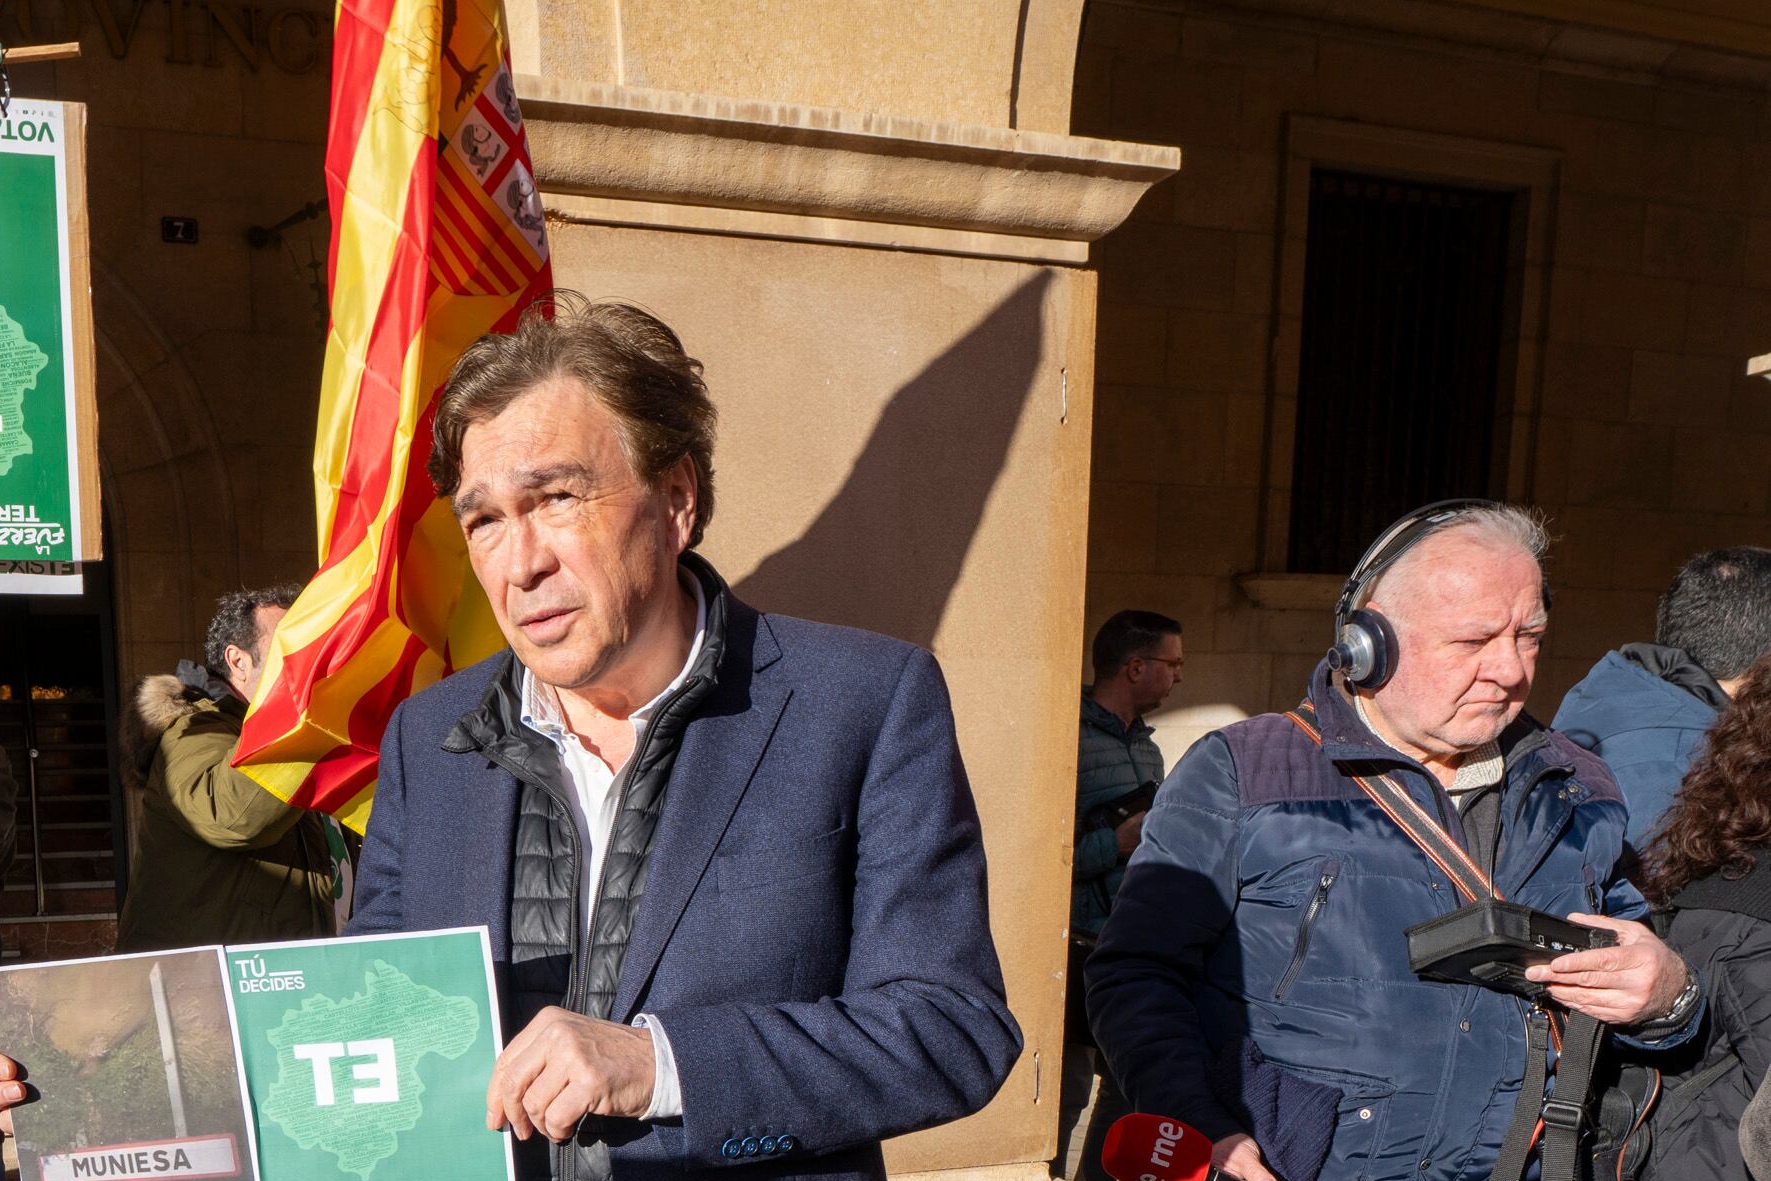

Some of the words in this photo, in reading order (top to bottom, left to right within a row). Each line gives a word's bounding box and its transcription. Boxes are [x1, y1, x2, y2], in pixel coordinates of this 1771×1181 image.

[173, 221, 185, 239] 7
[35, 544, 51, 555] LA
[235, 954, 267, 980] TÚ
[239, 976, 306, 994] DECIDES
[1150, 1121, 1184, 1168] rne
[72, 1148, 192, 1178] MUNIESA
